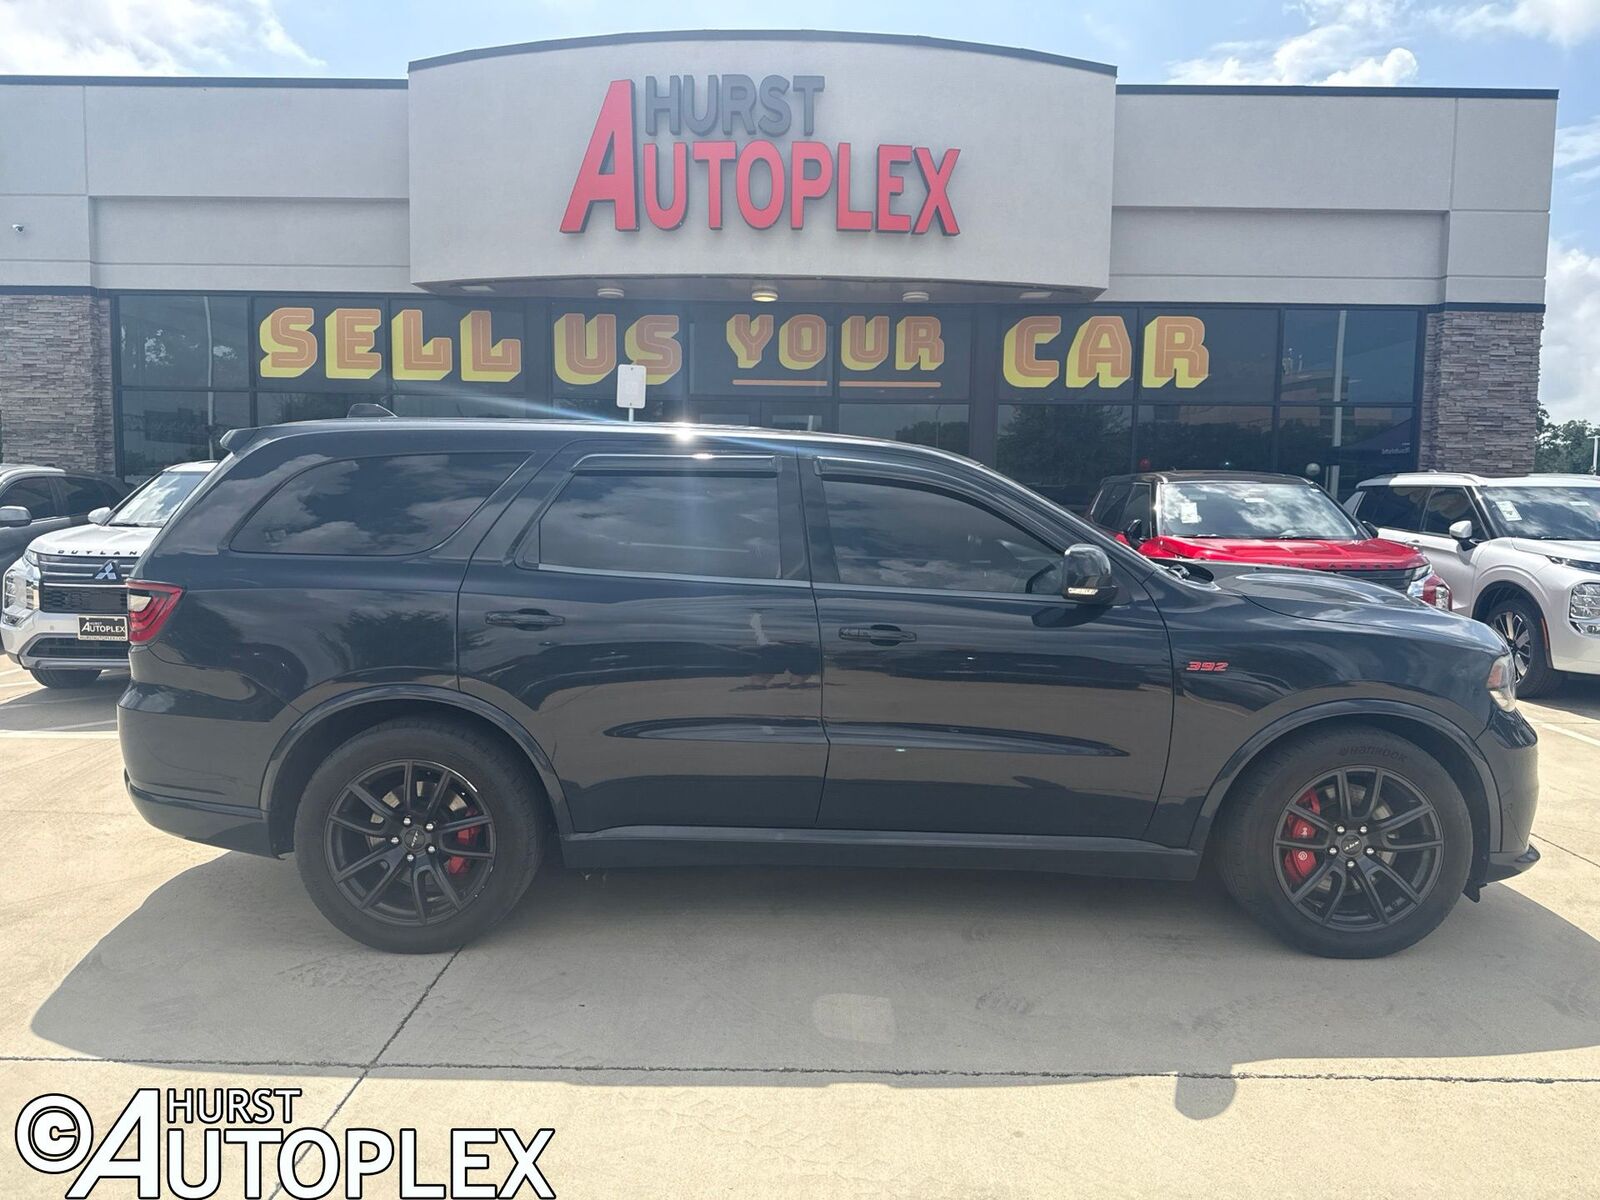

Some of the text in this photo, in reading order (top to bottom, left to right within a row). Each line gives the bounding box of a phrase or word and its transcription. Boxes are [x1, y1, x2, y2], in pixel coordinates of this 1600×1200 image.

[645, 74, 825, 136] HURST
[559, 79, 961, 236] AUTOPLEX
[259, 307, 1210, 389] SELL US YOUR CAR
[81, 621, 126, 633] AUTOPLEX
[1186, 661, 1229, 672] 392
